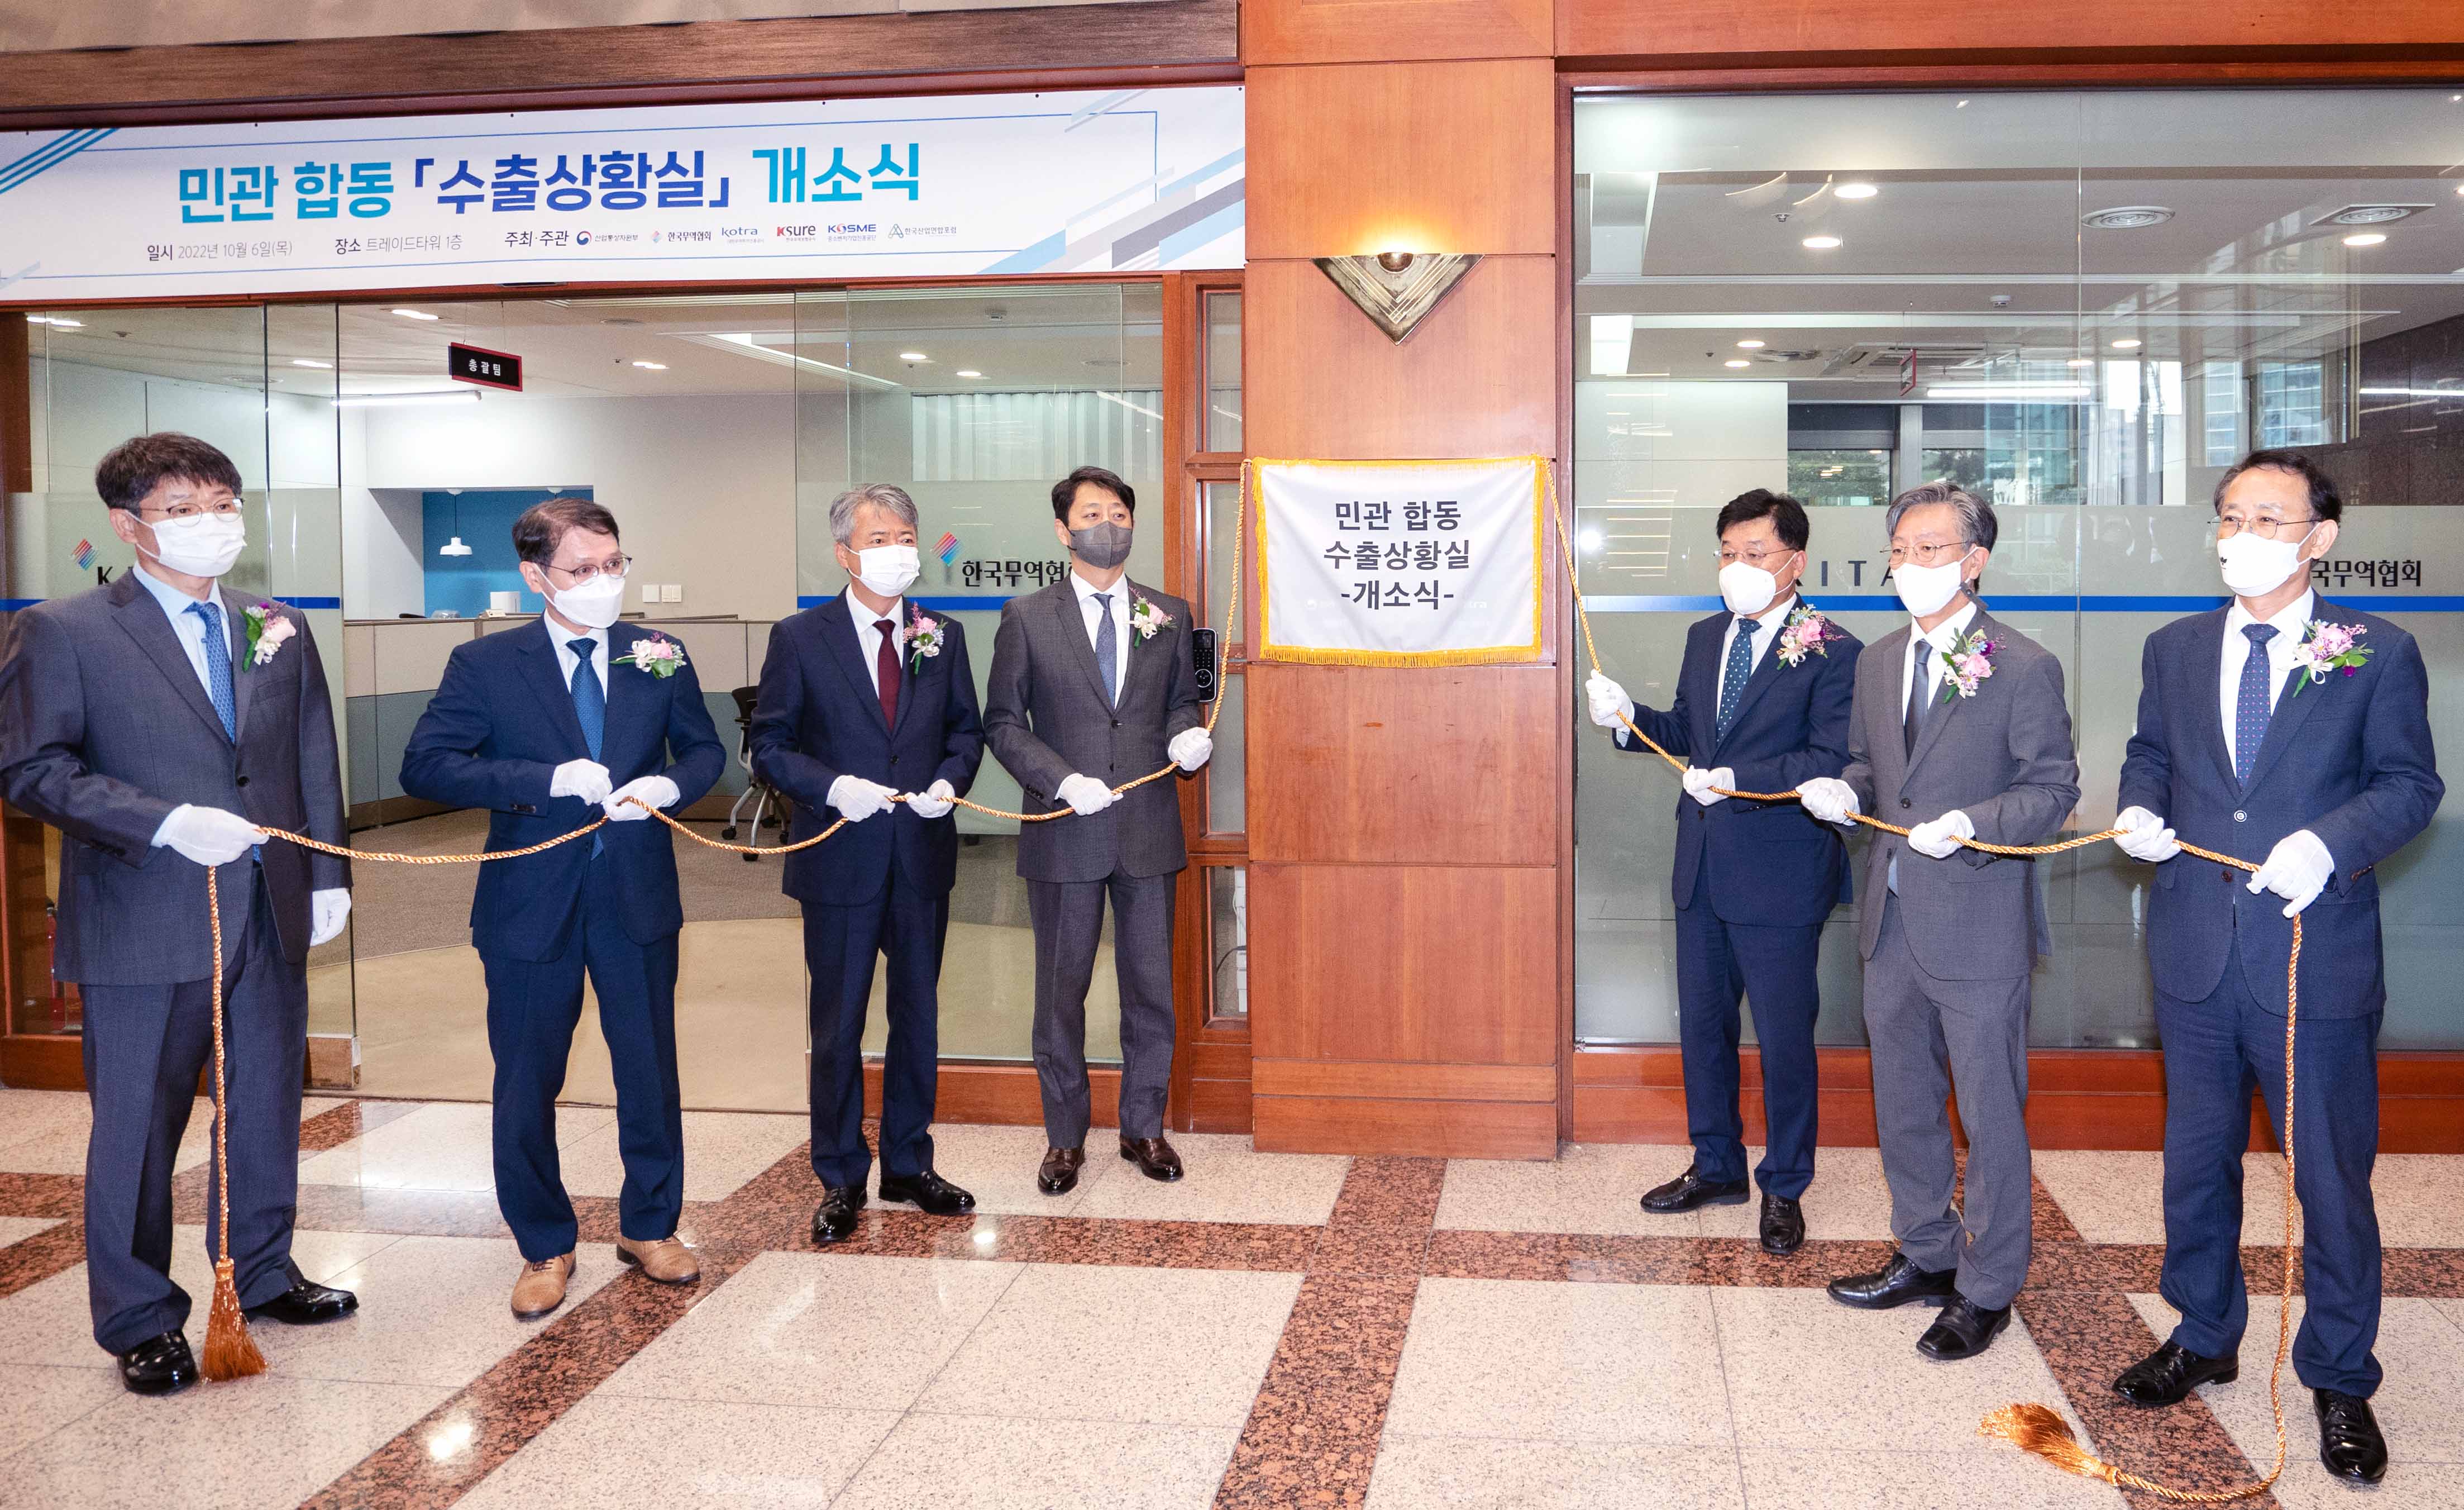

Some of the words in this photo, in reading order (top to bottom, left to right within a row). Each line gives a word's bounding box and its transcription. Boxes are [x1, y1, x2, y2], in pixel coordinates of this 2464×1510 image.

[179, 165, 279, 223] 민관
[294, 161, 394, 219] 합동
[752, 143, 919, 203] 개소식
[668, 231, 711, 241] 한국무역협회
[722, 227, 757, 237] kotra
[828, 223, 876, 234] KOSME
[147, 245, 172, 261] 일시
[179, 244, 218, 259] 2022년
[223, 242, 247, 258] 10월
[252, 241, 292, 257] 6일(목)
[335, 239, 361, 255] 장소
[366, 235, 441, 253] 트레이드타워
[447, 234, 462, 250] 1층
[1336, 501, 1392, 530] 민관
[1403, 501, 1461, 531] 합동
[1324, 540, 1469, 570] 수출상황실
[962, 560, 1071, 587] 한국무역협
[1341, 580, 1454, 609] -개소식-
